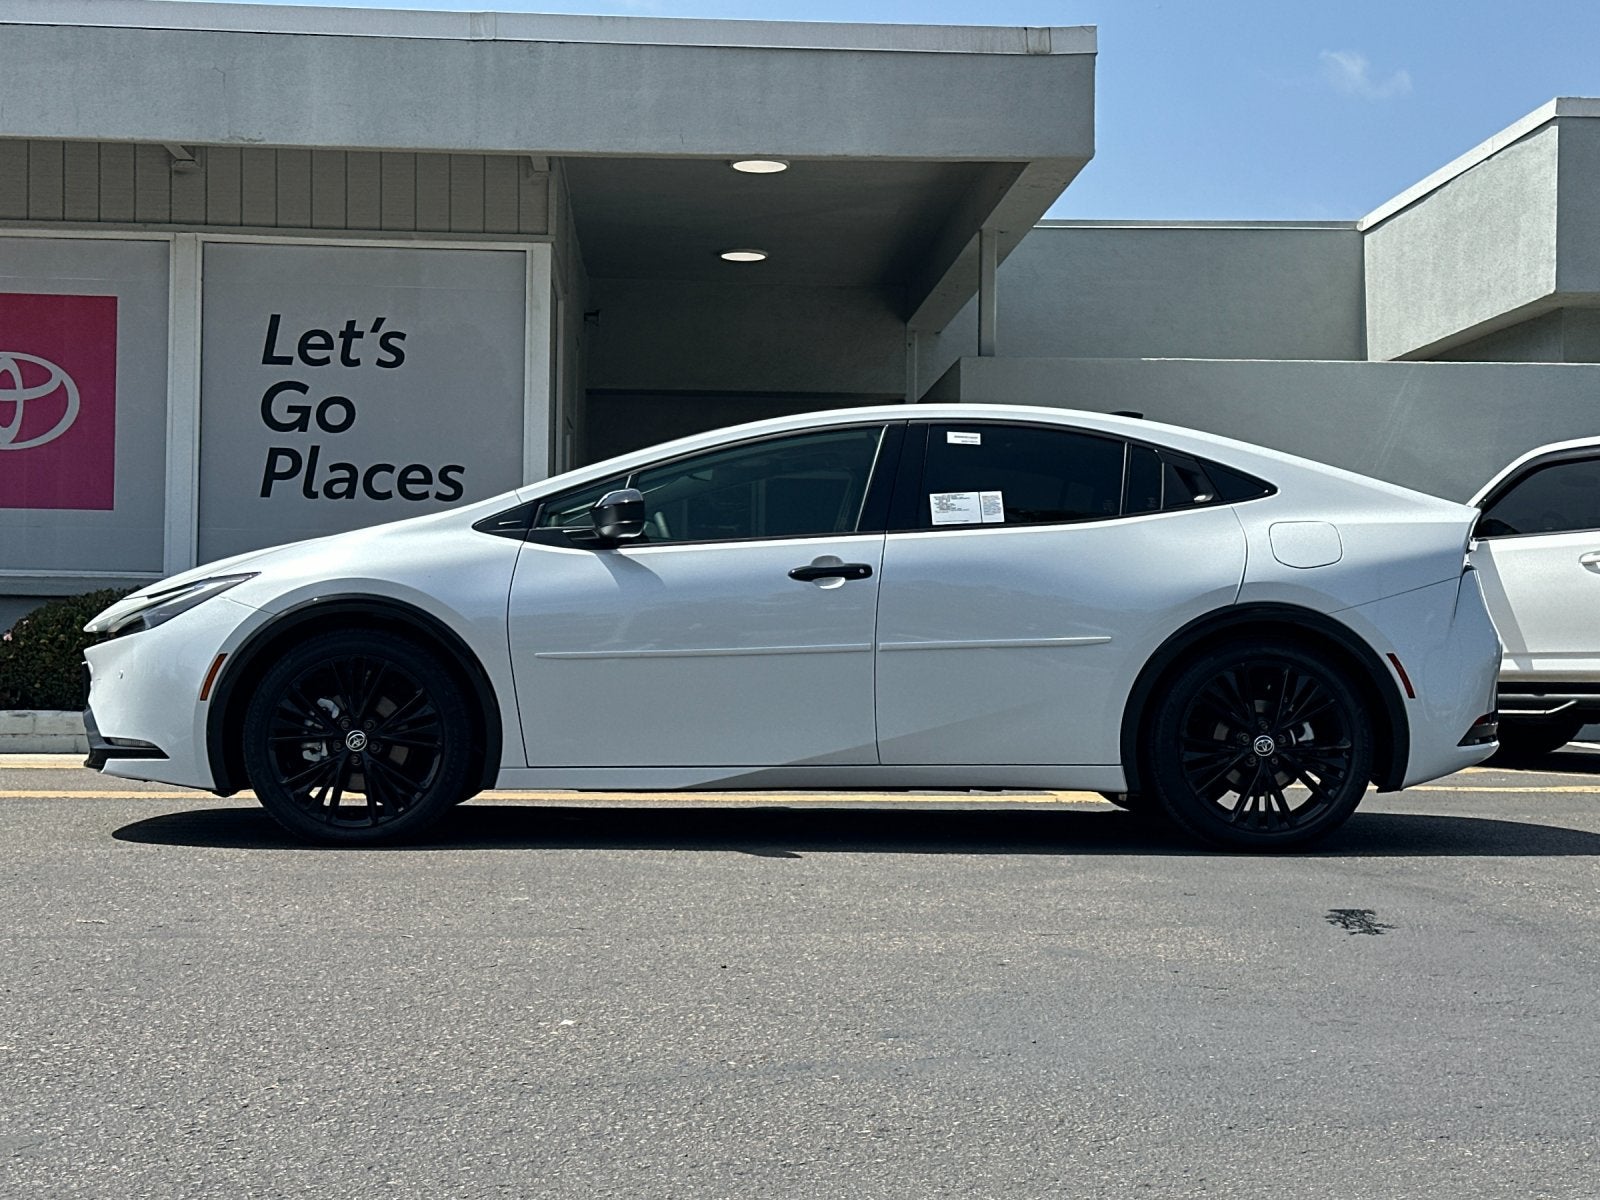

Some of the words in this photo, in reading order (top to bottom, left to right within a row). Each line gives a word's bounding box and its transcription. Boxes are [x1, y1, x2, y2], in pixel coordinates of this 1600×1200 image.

[261, 313, 407, 369] Let's
[260, 380, 357, 434] Go
[259, 445, 466, 503] Places
